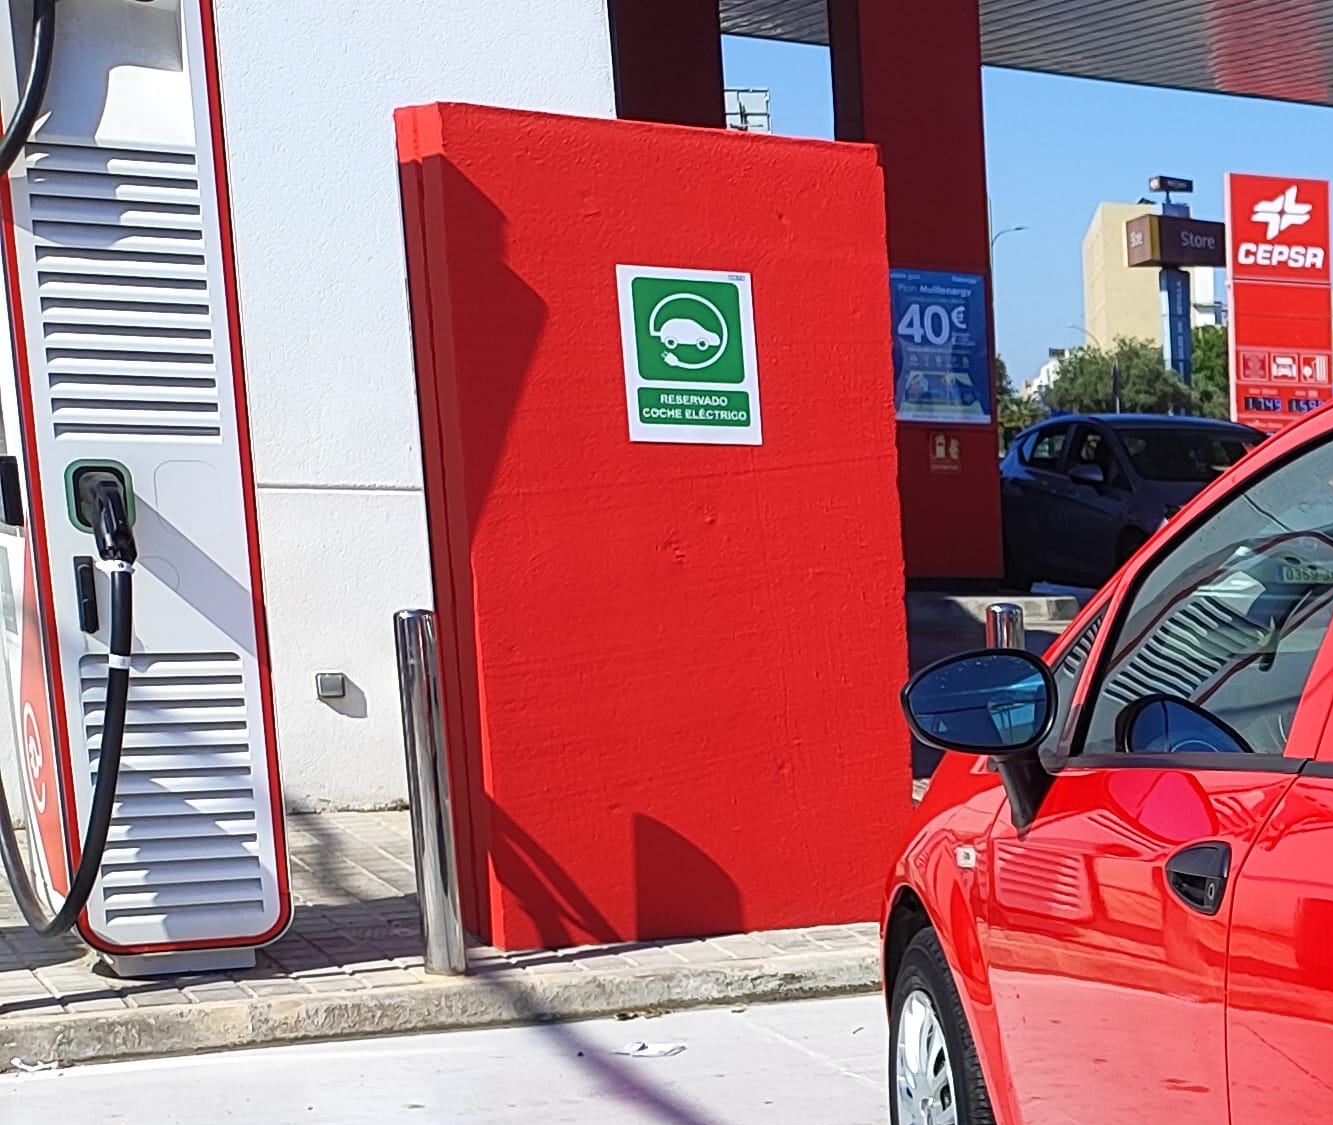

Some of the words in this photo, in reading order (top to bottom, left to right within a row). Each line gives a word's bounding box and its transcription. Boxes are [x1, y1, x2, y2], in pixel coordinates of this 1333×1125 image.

[1180, 230, 1216, 249] Store
[1237, 242, 1325, 269] CEPSA
[660, 394, 728, 406] RESERVADO
[642, 407, 682, 419] COCHE
[685, 407, 747, 421] ELÉCTRICO
